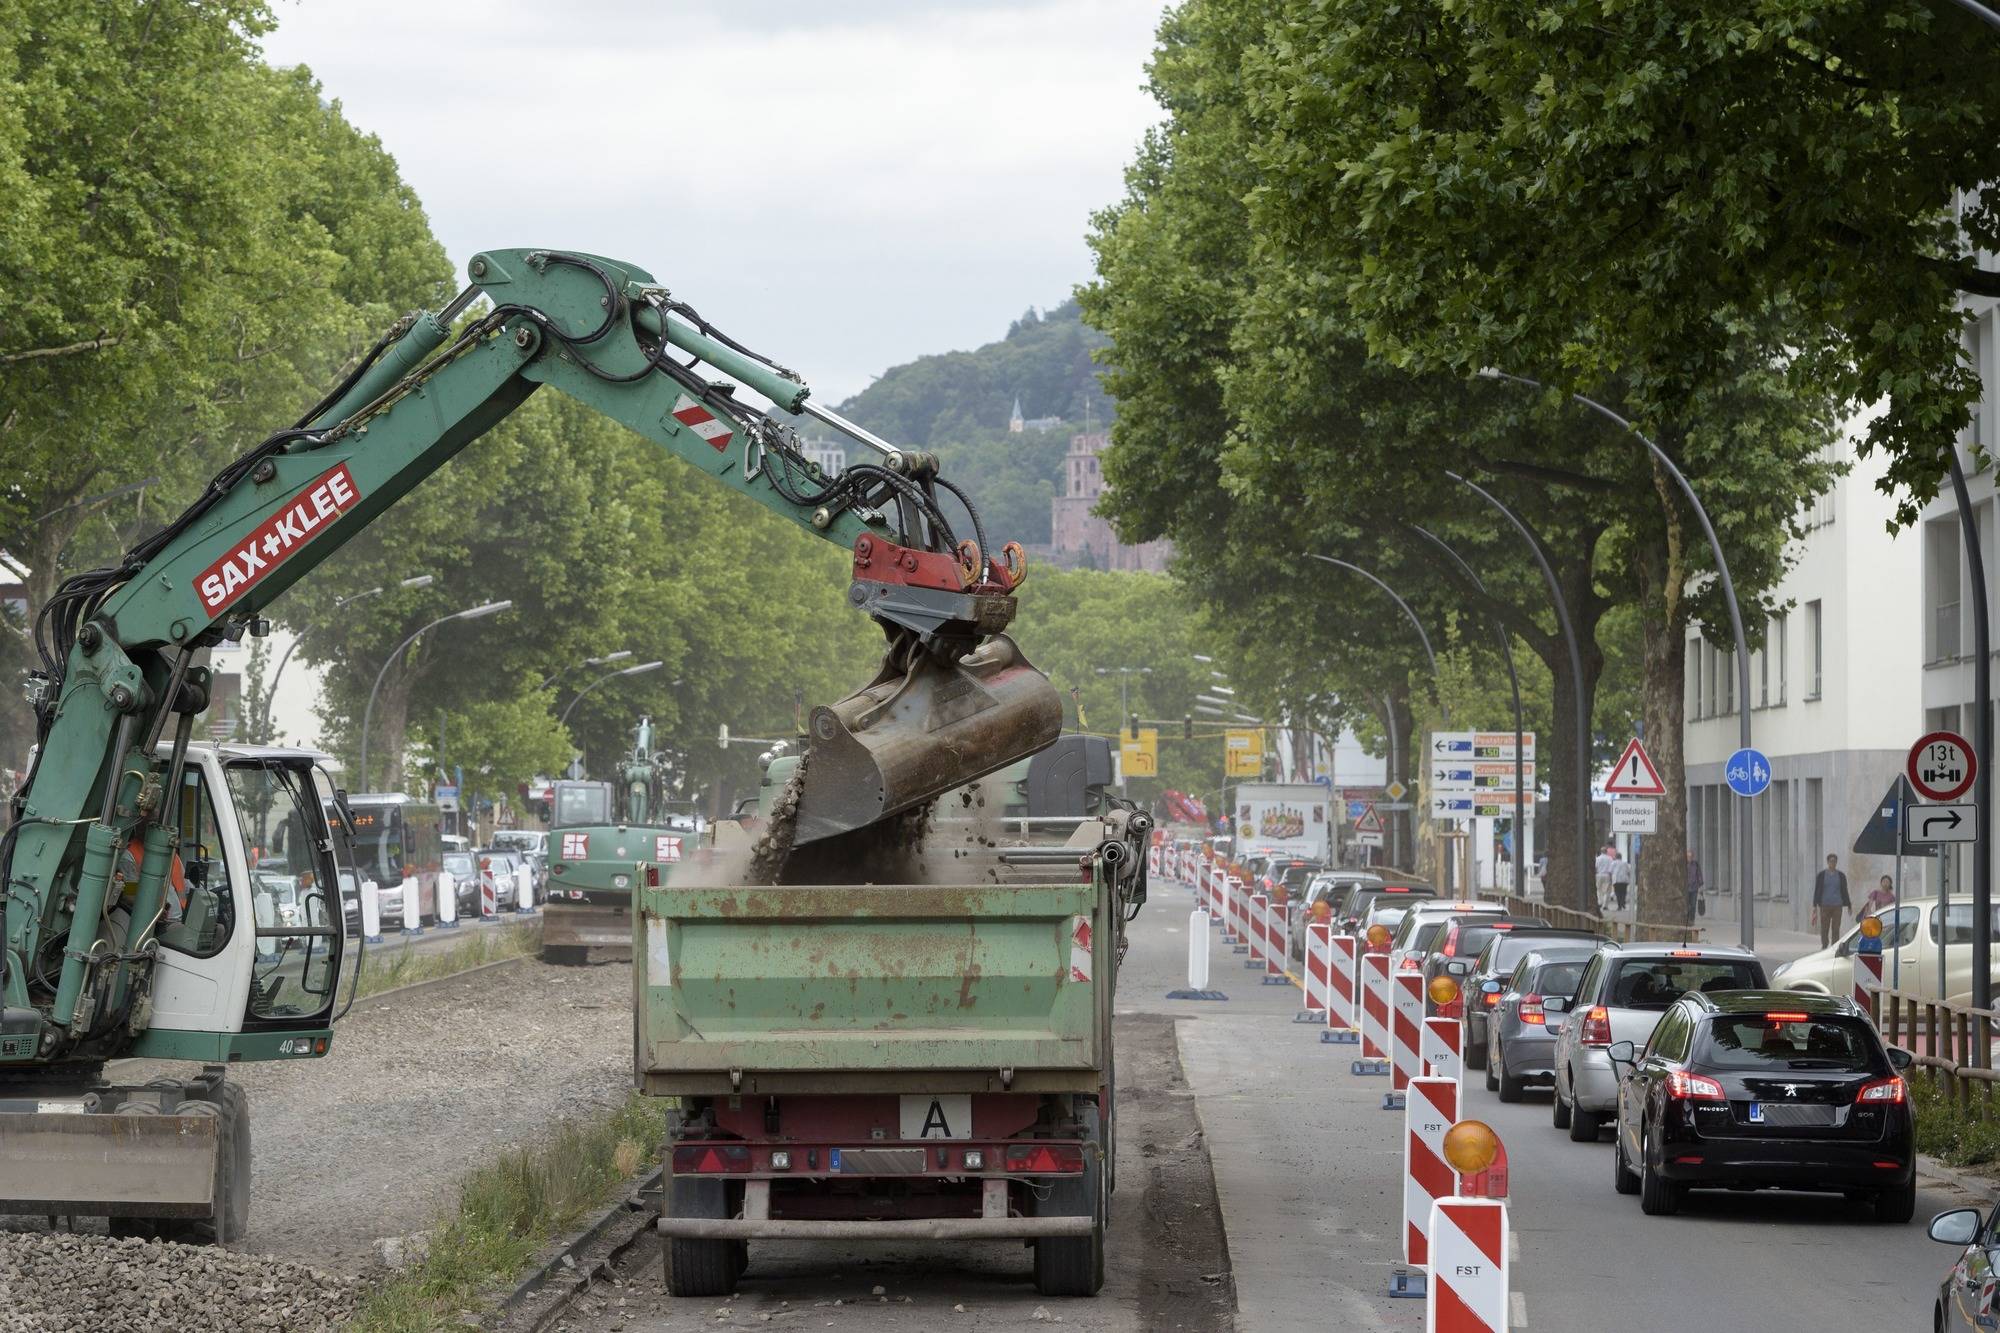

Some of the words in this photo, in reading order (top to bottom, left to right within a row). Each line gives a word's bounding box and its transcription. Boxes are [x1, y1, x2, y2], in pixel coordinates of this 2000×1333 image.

[201, 471, 354, 606] SAX+KLEE
[1482, 747, 1499, 757] 150
[1488, 777, 1499, 787] 60
[1482, 805, 1499, 815] 200
[1615, 807, 1654, 815] Grundstücks-
[1621, 818, 1645, 826] ausfahrt
[563, 834, 588, 855] SK
[656, 837, 682, 858] SK
[280, 1040, 293, 1053] 40
[920, 1101, 952, 1138] A
[1456, 1266, 1481, 1275] FST
